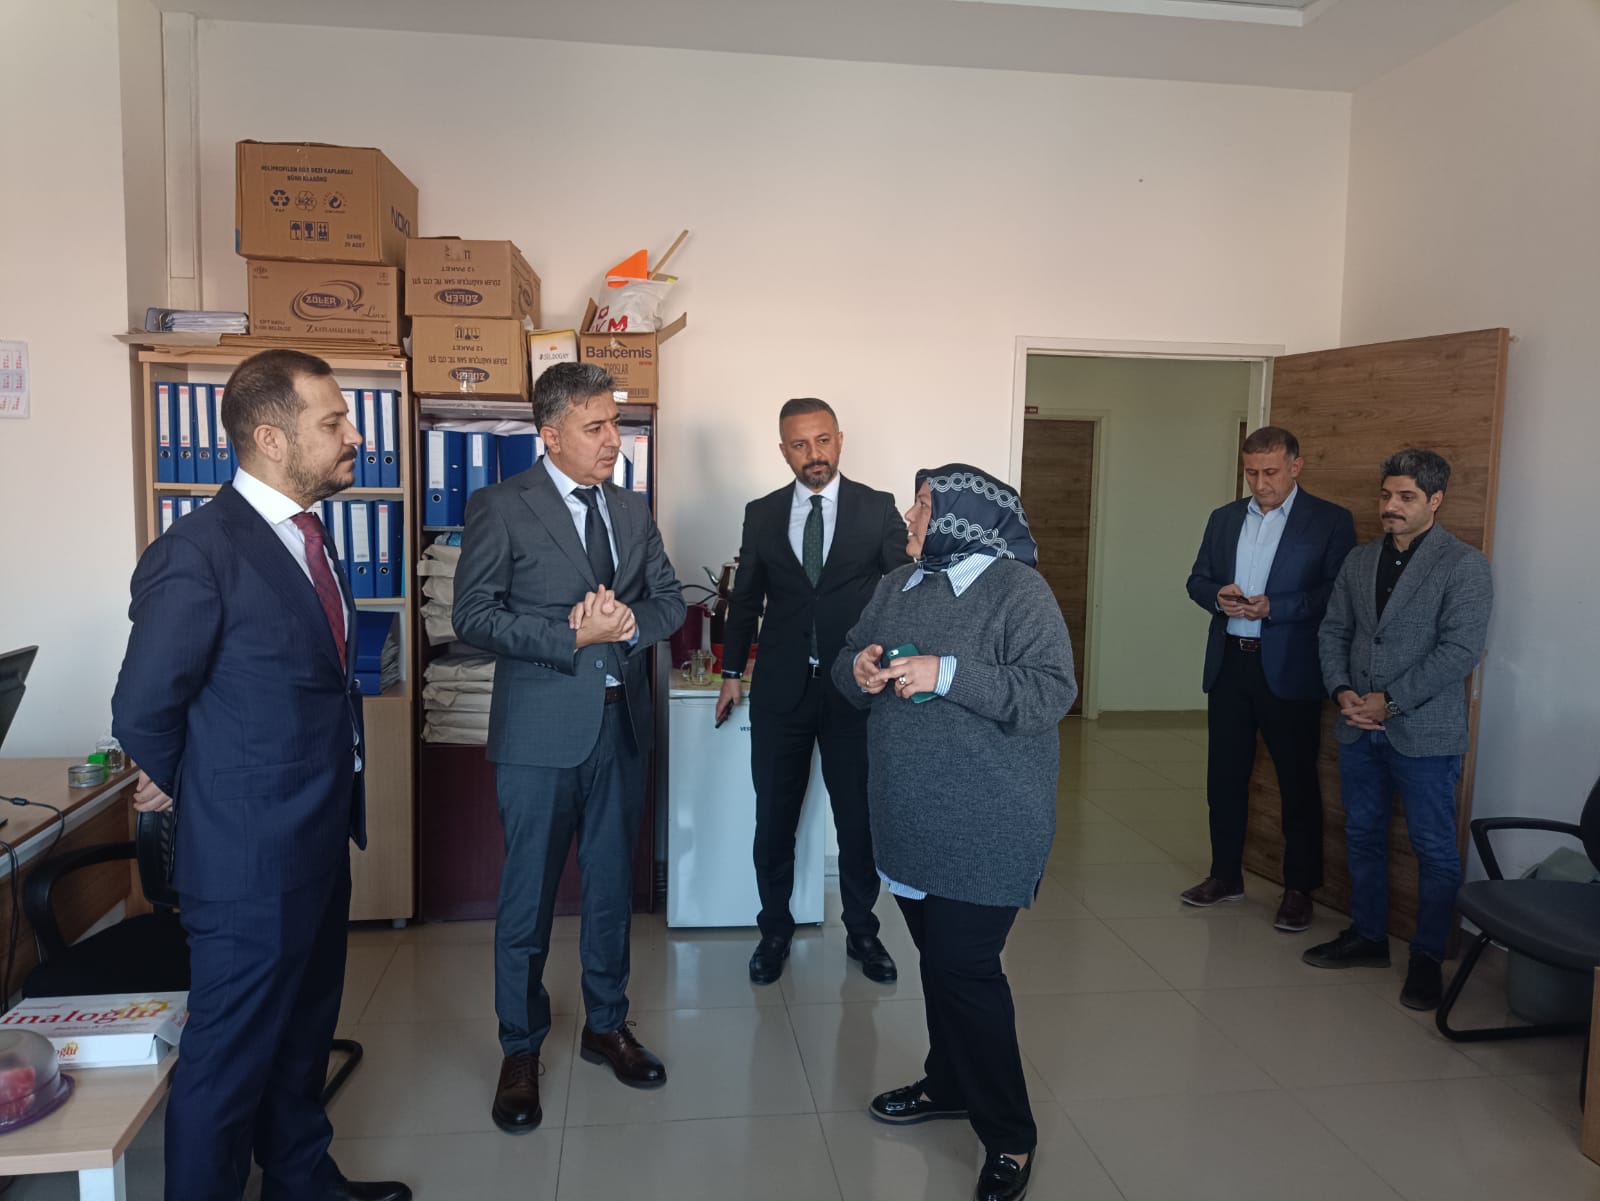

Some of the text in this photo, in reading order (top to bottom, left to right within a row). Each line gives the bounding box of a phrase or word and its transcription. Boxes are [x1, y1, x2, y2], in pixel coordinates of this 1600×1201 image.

[305, 294, 337, 306] ZÜLER
[445, 292, 479, 305] ZÜLER
[586, 346, 653, 359] Bahçemis
